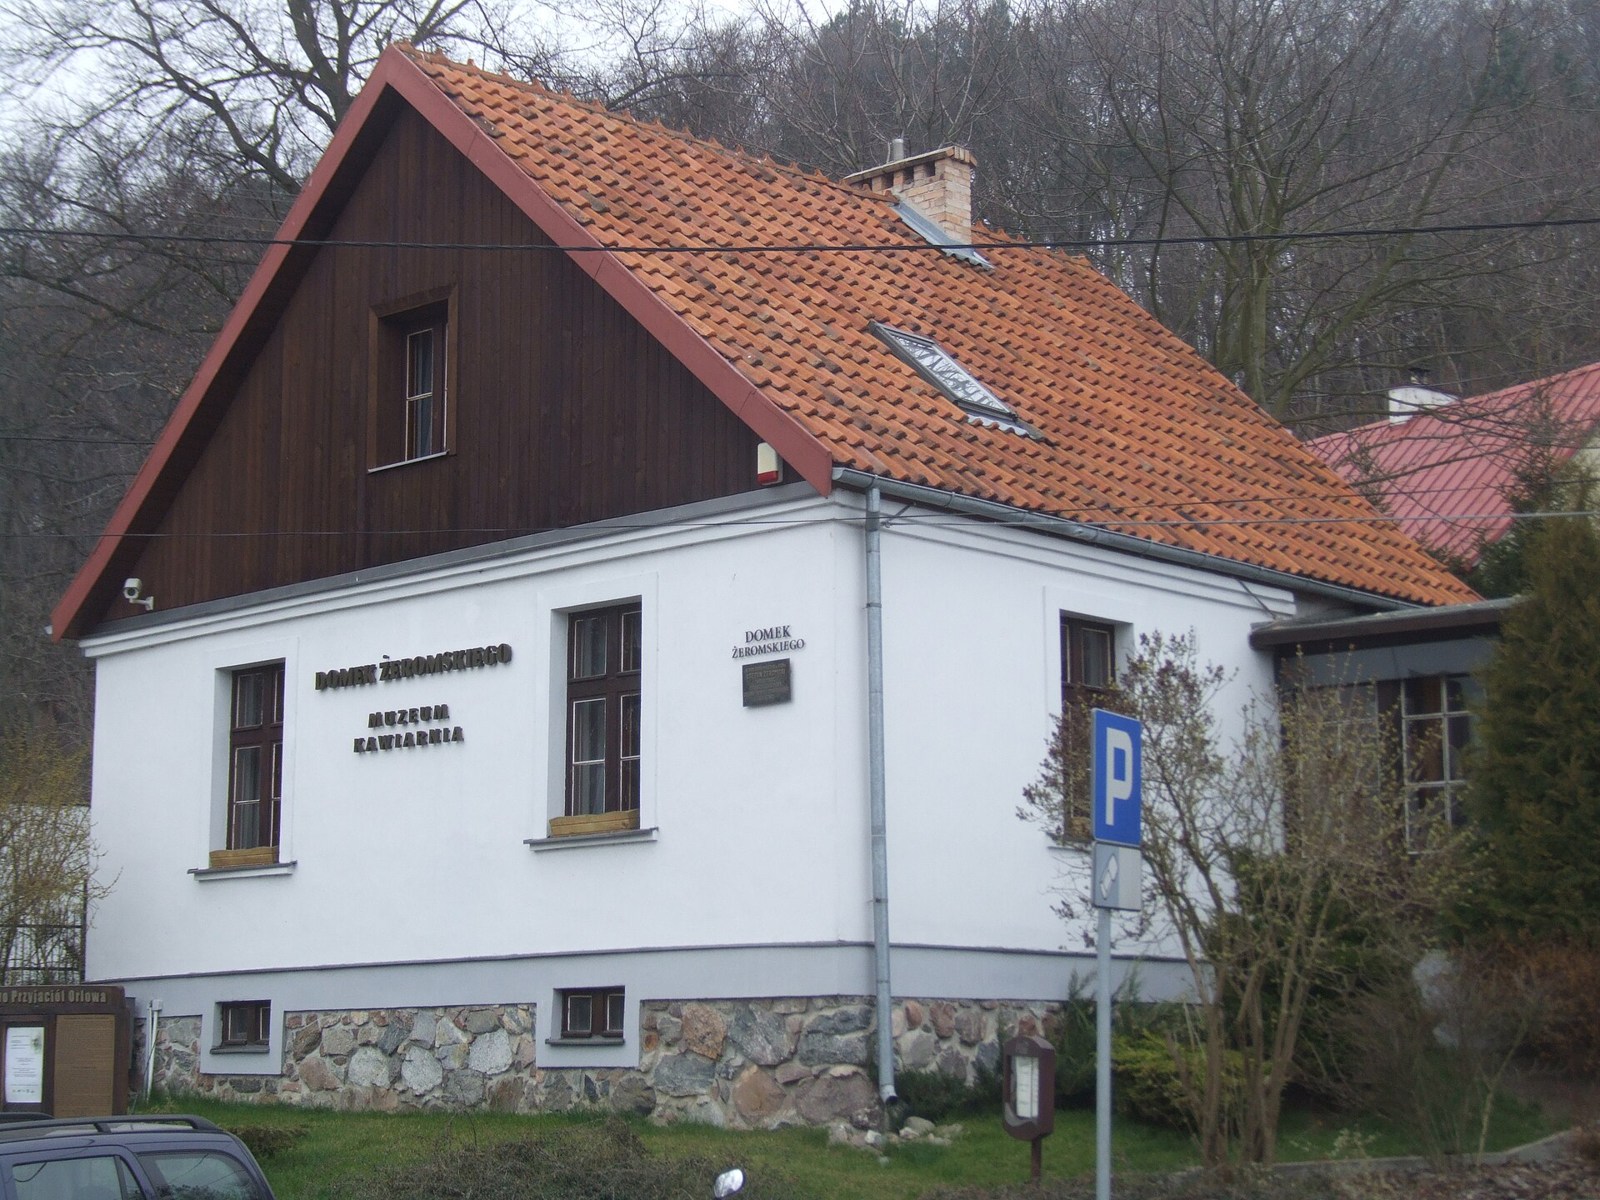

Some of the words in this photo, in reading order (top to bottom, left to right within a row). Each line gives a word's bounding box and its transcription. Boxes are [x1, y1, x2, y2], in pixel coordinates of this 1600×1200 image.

[745, 625, 791, 643] DOMEK
[732, 638, 806, 658] ŻEROMSKIEGO
[315, 664, 377, 690] DOMEK
[379, 643, 513, 681] ŻEROMSKIEGO
[368, 704, 450, 728] MUZEUM
[353, 726, 464, 753] KAWIARNIA
[1106, 727, 1133, 826] P
